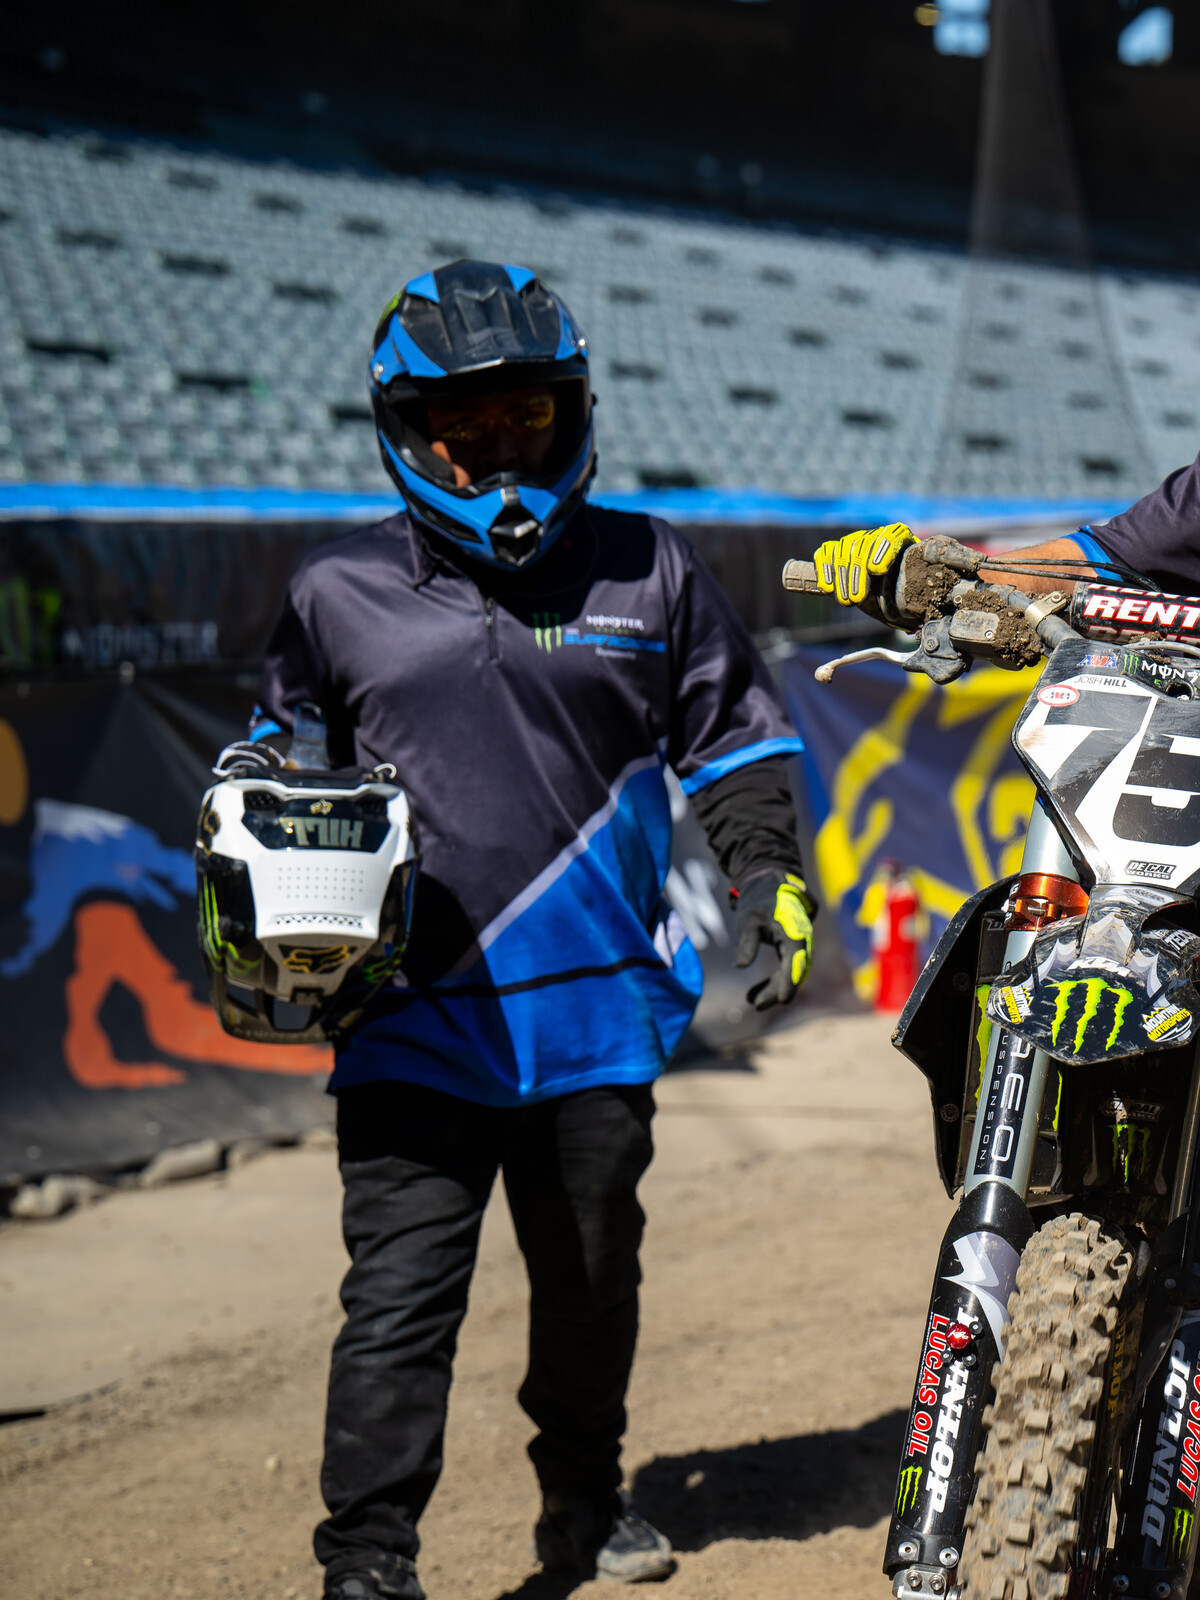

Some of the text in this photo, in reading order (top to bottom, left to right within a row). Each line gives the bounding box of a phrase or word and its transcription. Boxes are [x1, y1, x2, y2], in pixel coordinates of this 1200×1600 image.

[1076, 654, 1118, 669] AMA
[1074, 675, 1128, 688] JOSH HILL
[279, 816, 364, 849] HILL
[1126, 869, 1172, 880] WORKS
[1127, 860, 1176, 875] DECAL
[1067, 956, 1131, 978] KTM
[1142, 1003, 1181, 1033] MOUNTAIN
[1147, 1008, 1192, 1042] MOTORSPORTS
[979, 1034, 1009, 1160] USPENSION
[908, 1312, 950, 1458] LUCAS OIL
[1140, 1338, 1192, 1547] DUNLOP
